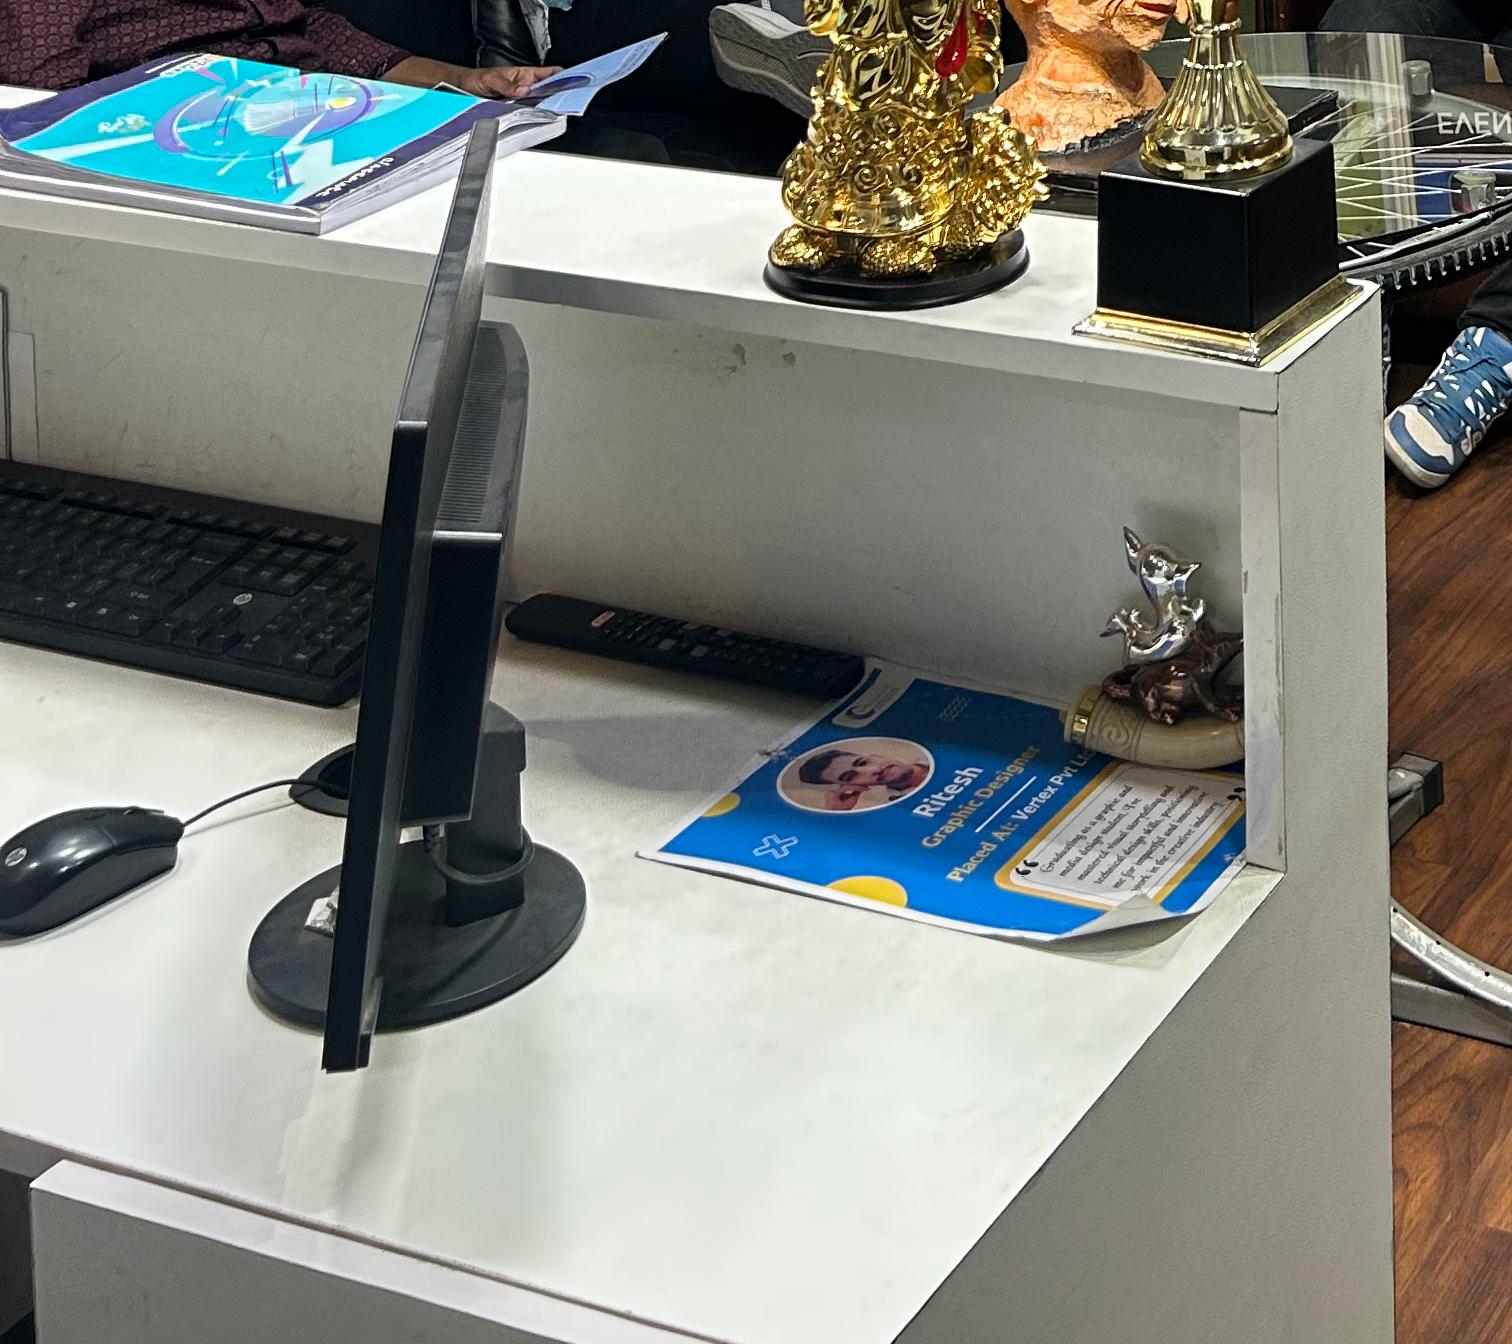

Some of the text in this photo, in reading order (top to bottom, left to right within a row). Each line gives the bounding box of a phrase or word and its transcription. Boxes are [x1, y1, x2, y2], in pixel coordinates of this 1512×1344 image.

[912, 766, 984, 818] Ritesh
[922, 744, 1041, 849] Graphic Designer
[946, 841, 998, 882] Placed
[1011, 782, 1058, 821] Vertex
[1050, 765, 1078, 786] Pvt
